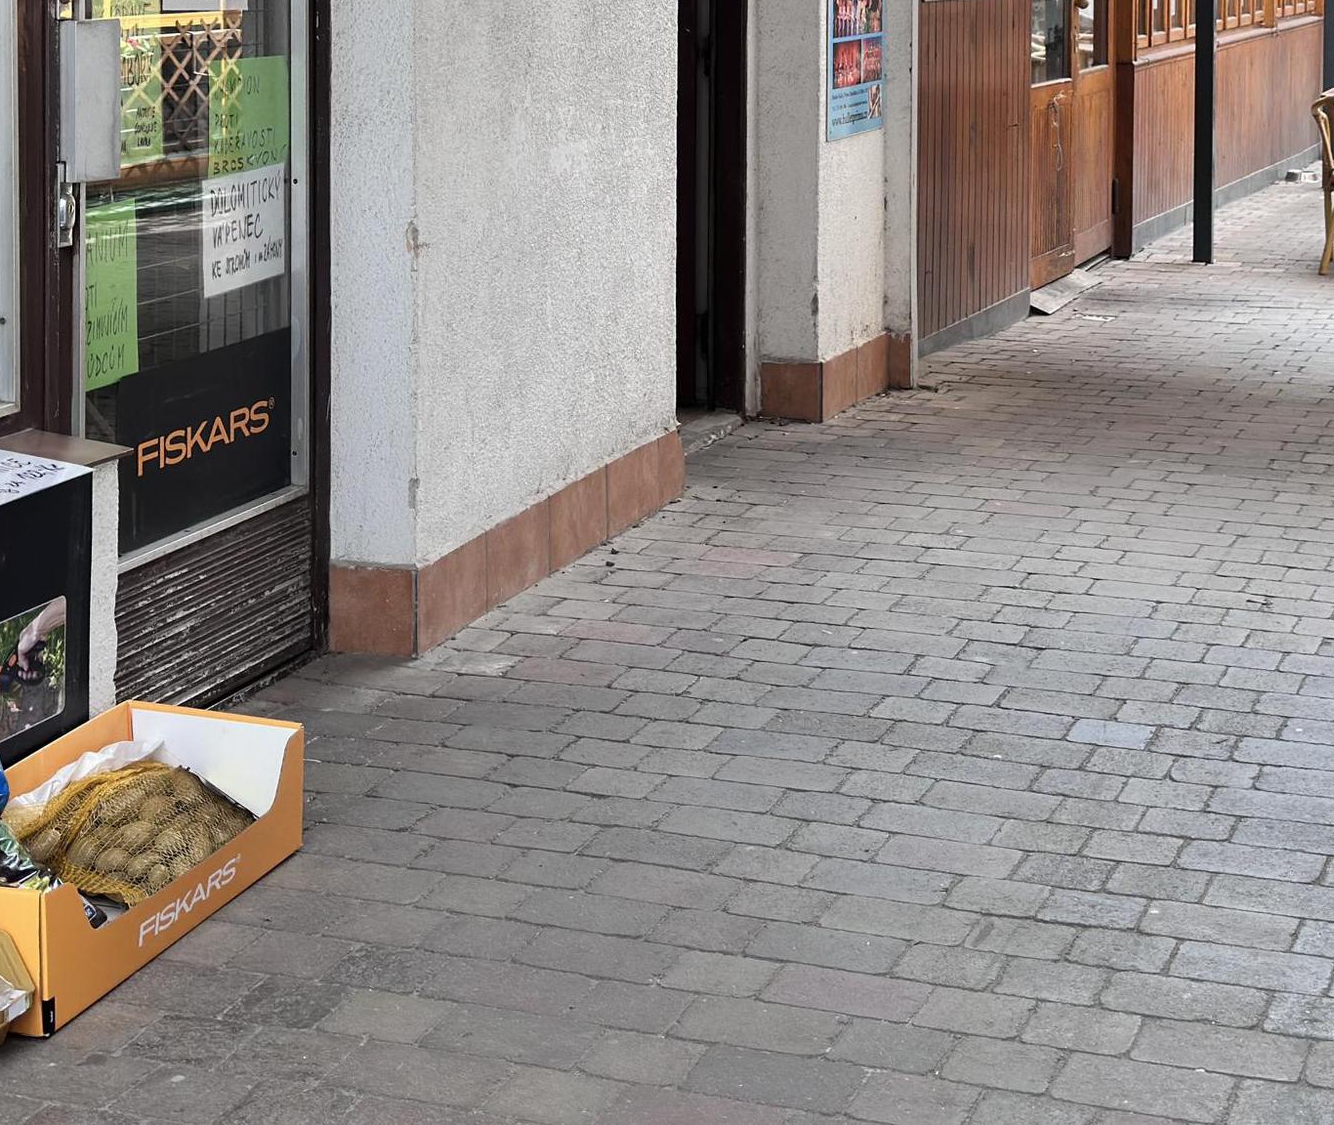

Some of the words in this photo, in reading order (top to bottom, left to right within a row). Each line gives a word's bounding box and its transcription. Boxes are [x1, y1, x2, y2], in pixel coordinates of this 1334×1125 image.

[210, 170, 282, 218] DOLOMITICKÝ
[212, 212, 264, 249] VÁPENEC
[211, 260, 222, 280] KE
